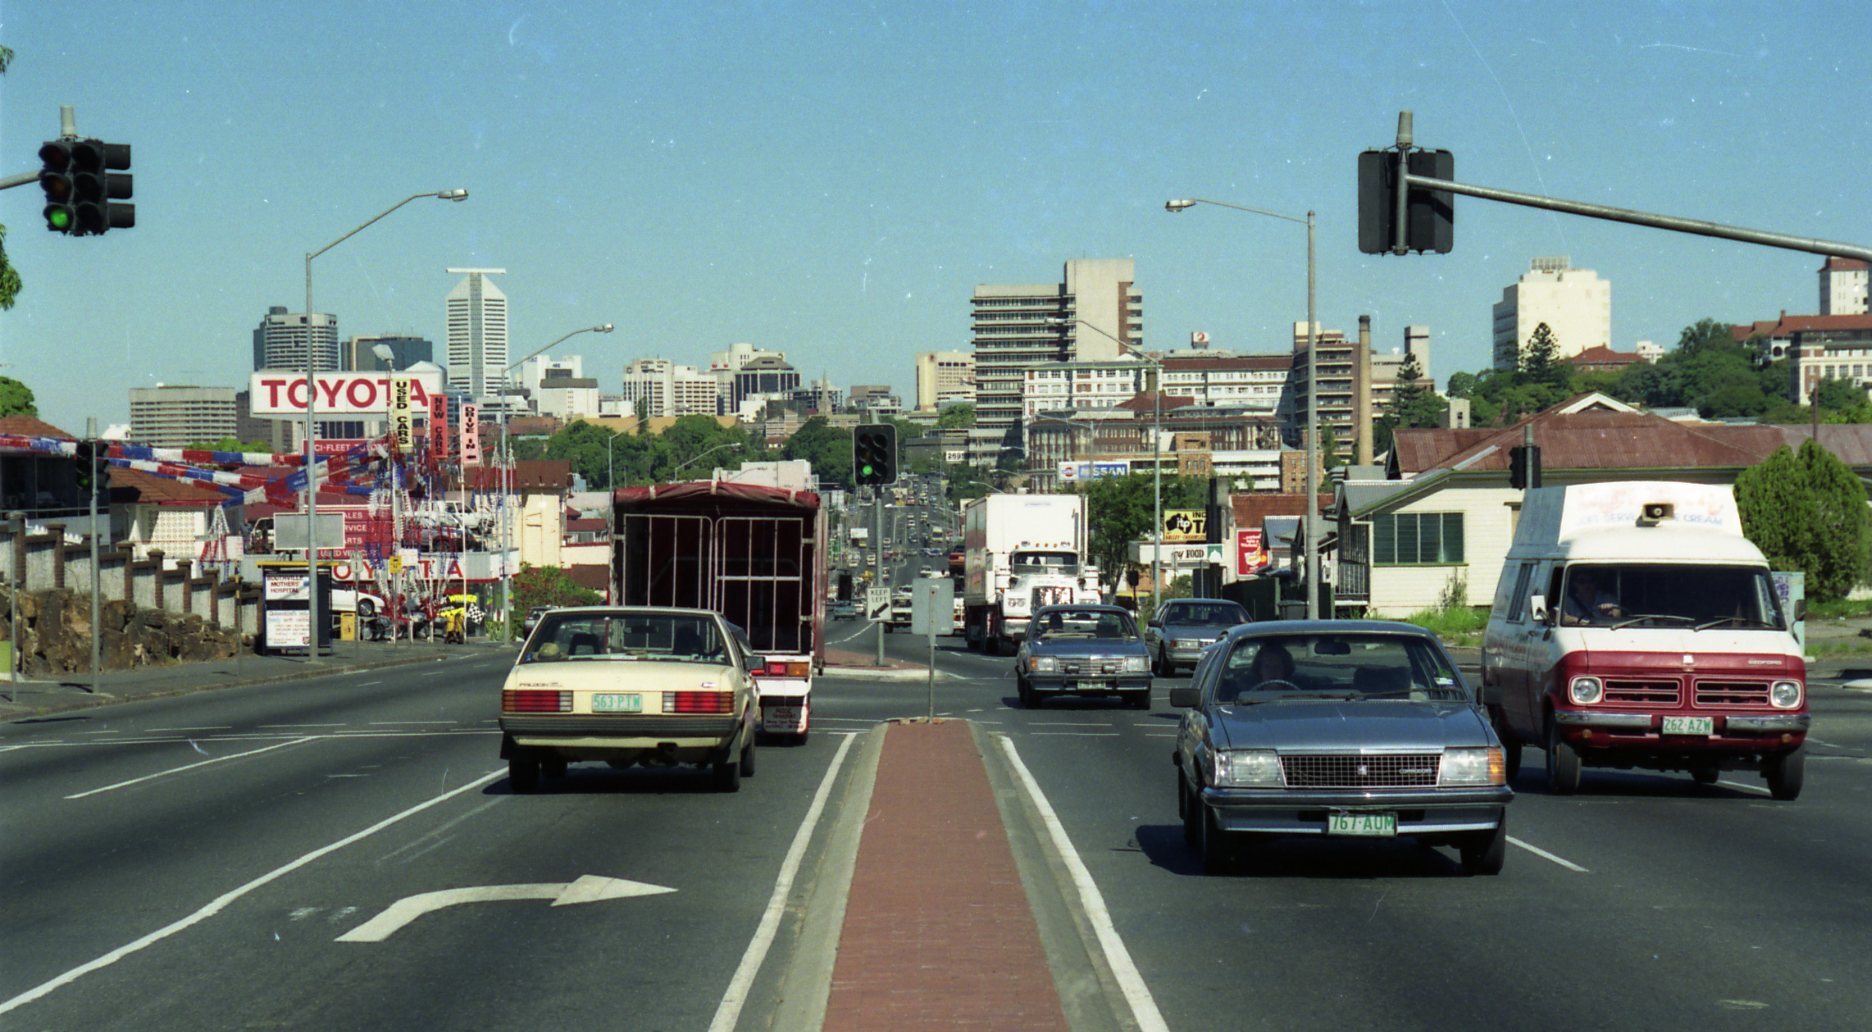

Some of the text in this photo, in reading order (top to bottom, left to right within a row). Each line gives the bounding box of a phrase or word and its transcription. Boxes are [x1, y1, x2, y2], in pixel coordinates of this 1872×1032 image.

[261, 378, 429, 408] TOYOTA
[396, 381, 409, 445] USED CARS
[434, 397, 444, 455] NEW CARS
[465, 407, 476, 450] DRIVE IN
[311, 444, 350, 452] CI-FLEET
